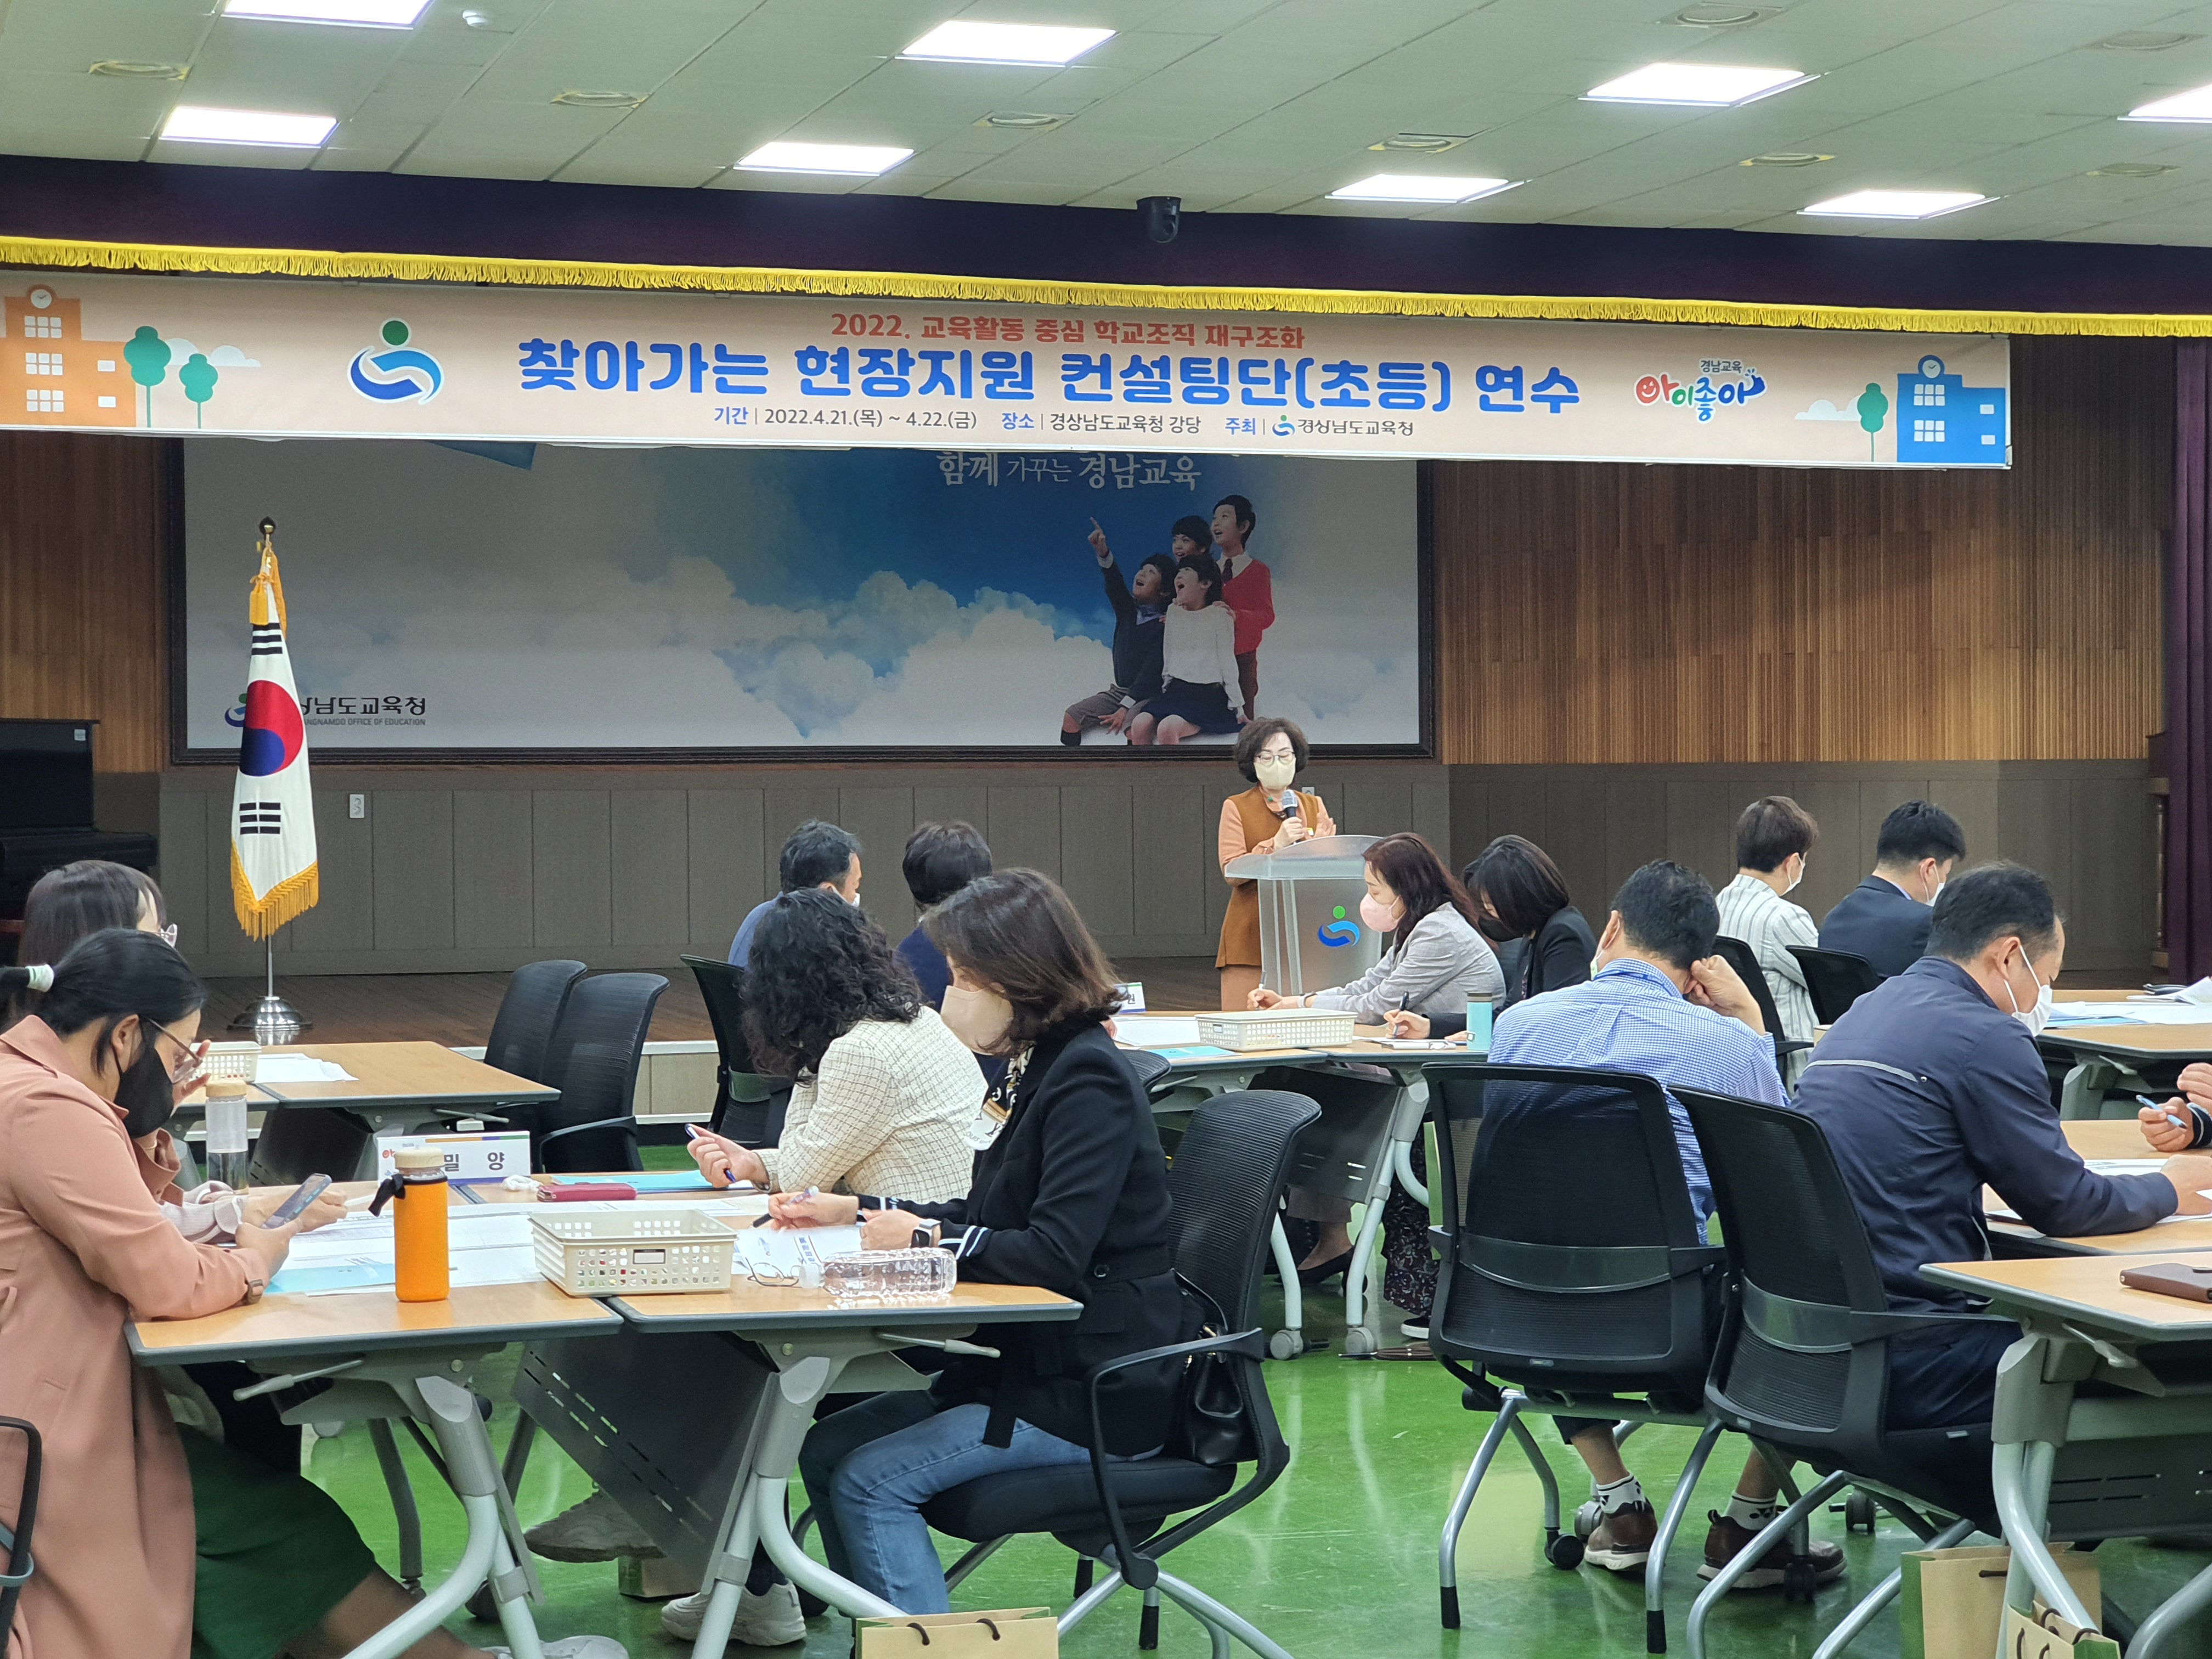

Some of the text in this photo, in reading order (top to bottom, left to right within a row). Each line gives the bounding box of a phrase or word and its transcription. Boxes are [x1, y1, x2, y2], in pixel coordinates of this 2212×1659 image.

[831, 313, 1305, 349] 2022. 교육활동 중심 학교조직 재구조화
[518, 338, 1580, 414] 찾아가는 현장지원 컨설팅단(초등) 연수
[1701, 360, 1742, 374] 경남교육
[1636, 374, 1765, 421] 아이좋아
[714, 406, 749, 425] 기간
[764, 408, 883, 428] 2022.4.21.(목)
[906, 411, 977, 429] 4.22.(금)
[1002, 412, 1201, 434] 장소 경상남도교육청 강당
[1225, 417, 1414, 436] 주최 경상남도교육청
[936, 452, 1202, 491] 함께 가꾸는 경남교육
